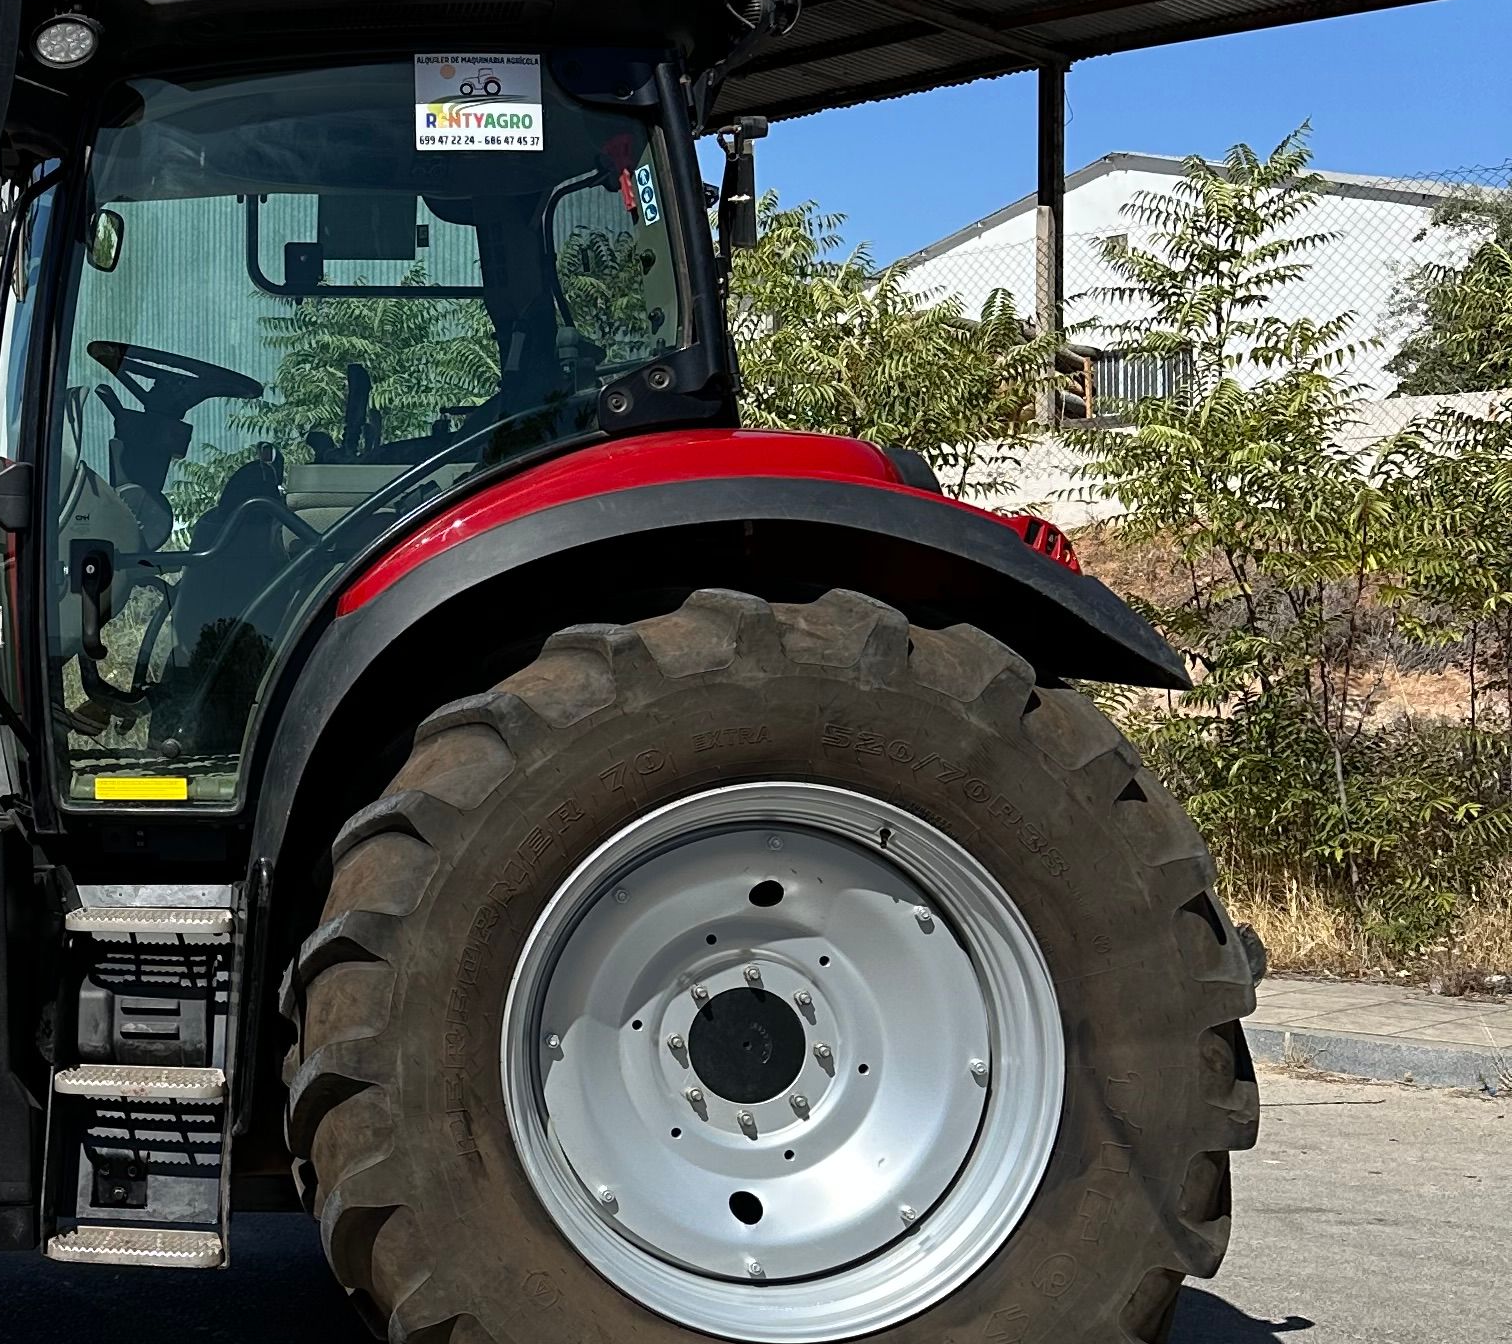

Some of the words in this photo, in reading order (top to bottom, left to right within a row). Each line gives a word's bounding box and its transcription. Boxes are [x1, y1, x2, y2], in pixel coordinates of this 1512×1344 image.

[426, 112, 533, 129] RENTYAGRO
[419, 135, 435, 145] 699
[438, 135, 448, 145] 47
[451, 135, 462, 145] 22
[464, 135, 475, 145] 24
[484, 135, 501, 145] 686
[503, 135, 514, 145] 47
[517, 136, 527, 146] 45
[530, 136, 540, 146] 37
[688, 722, 772, 756] EXTRA
